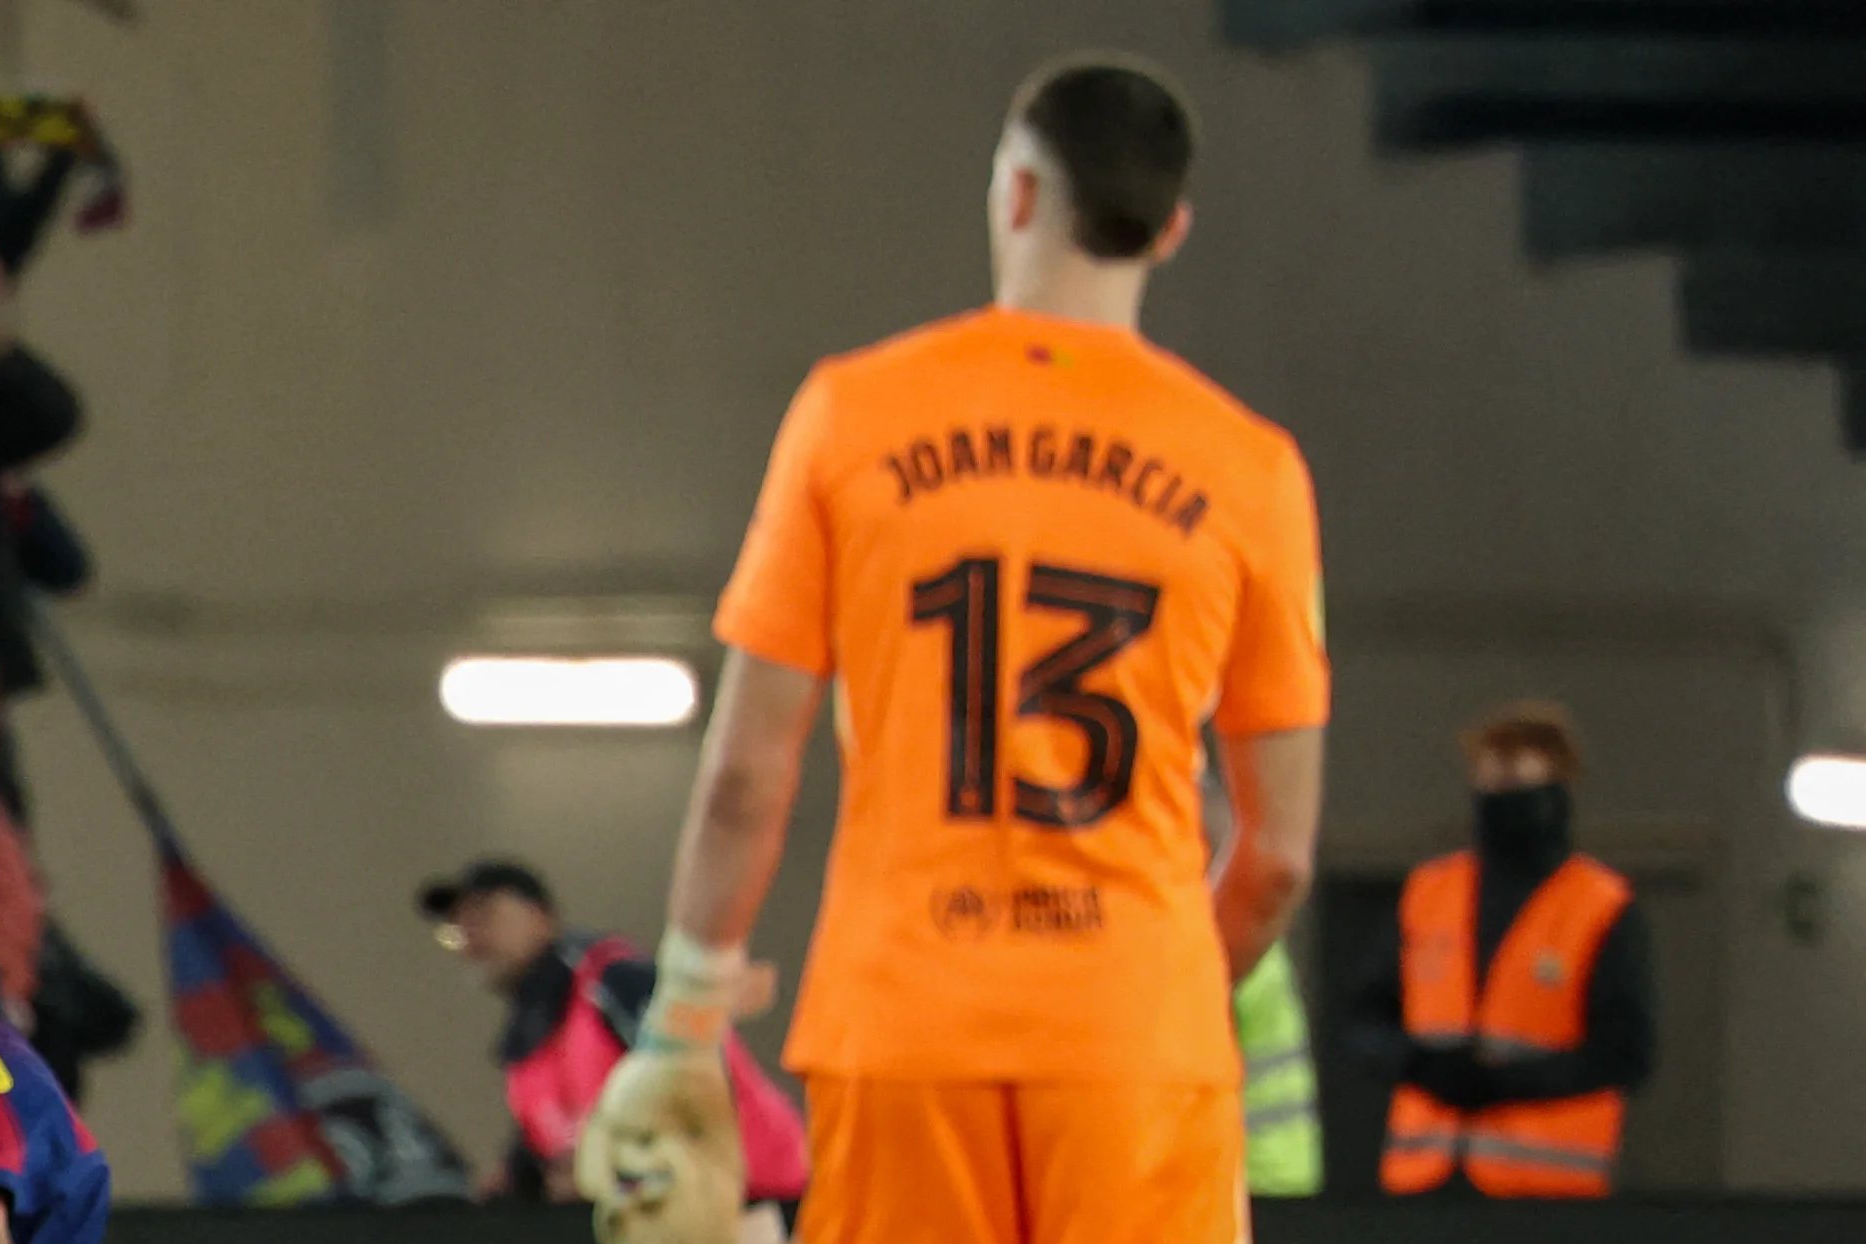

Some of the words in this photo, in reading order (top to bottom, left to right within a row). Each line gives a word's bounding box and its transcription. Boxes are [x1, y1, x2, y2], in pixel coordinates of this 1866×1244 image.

[886, 427, 1013, 503] JOAN
[1028, 427, 1208, 536] GARCIA
[910, 557, 1161, 826] 13
